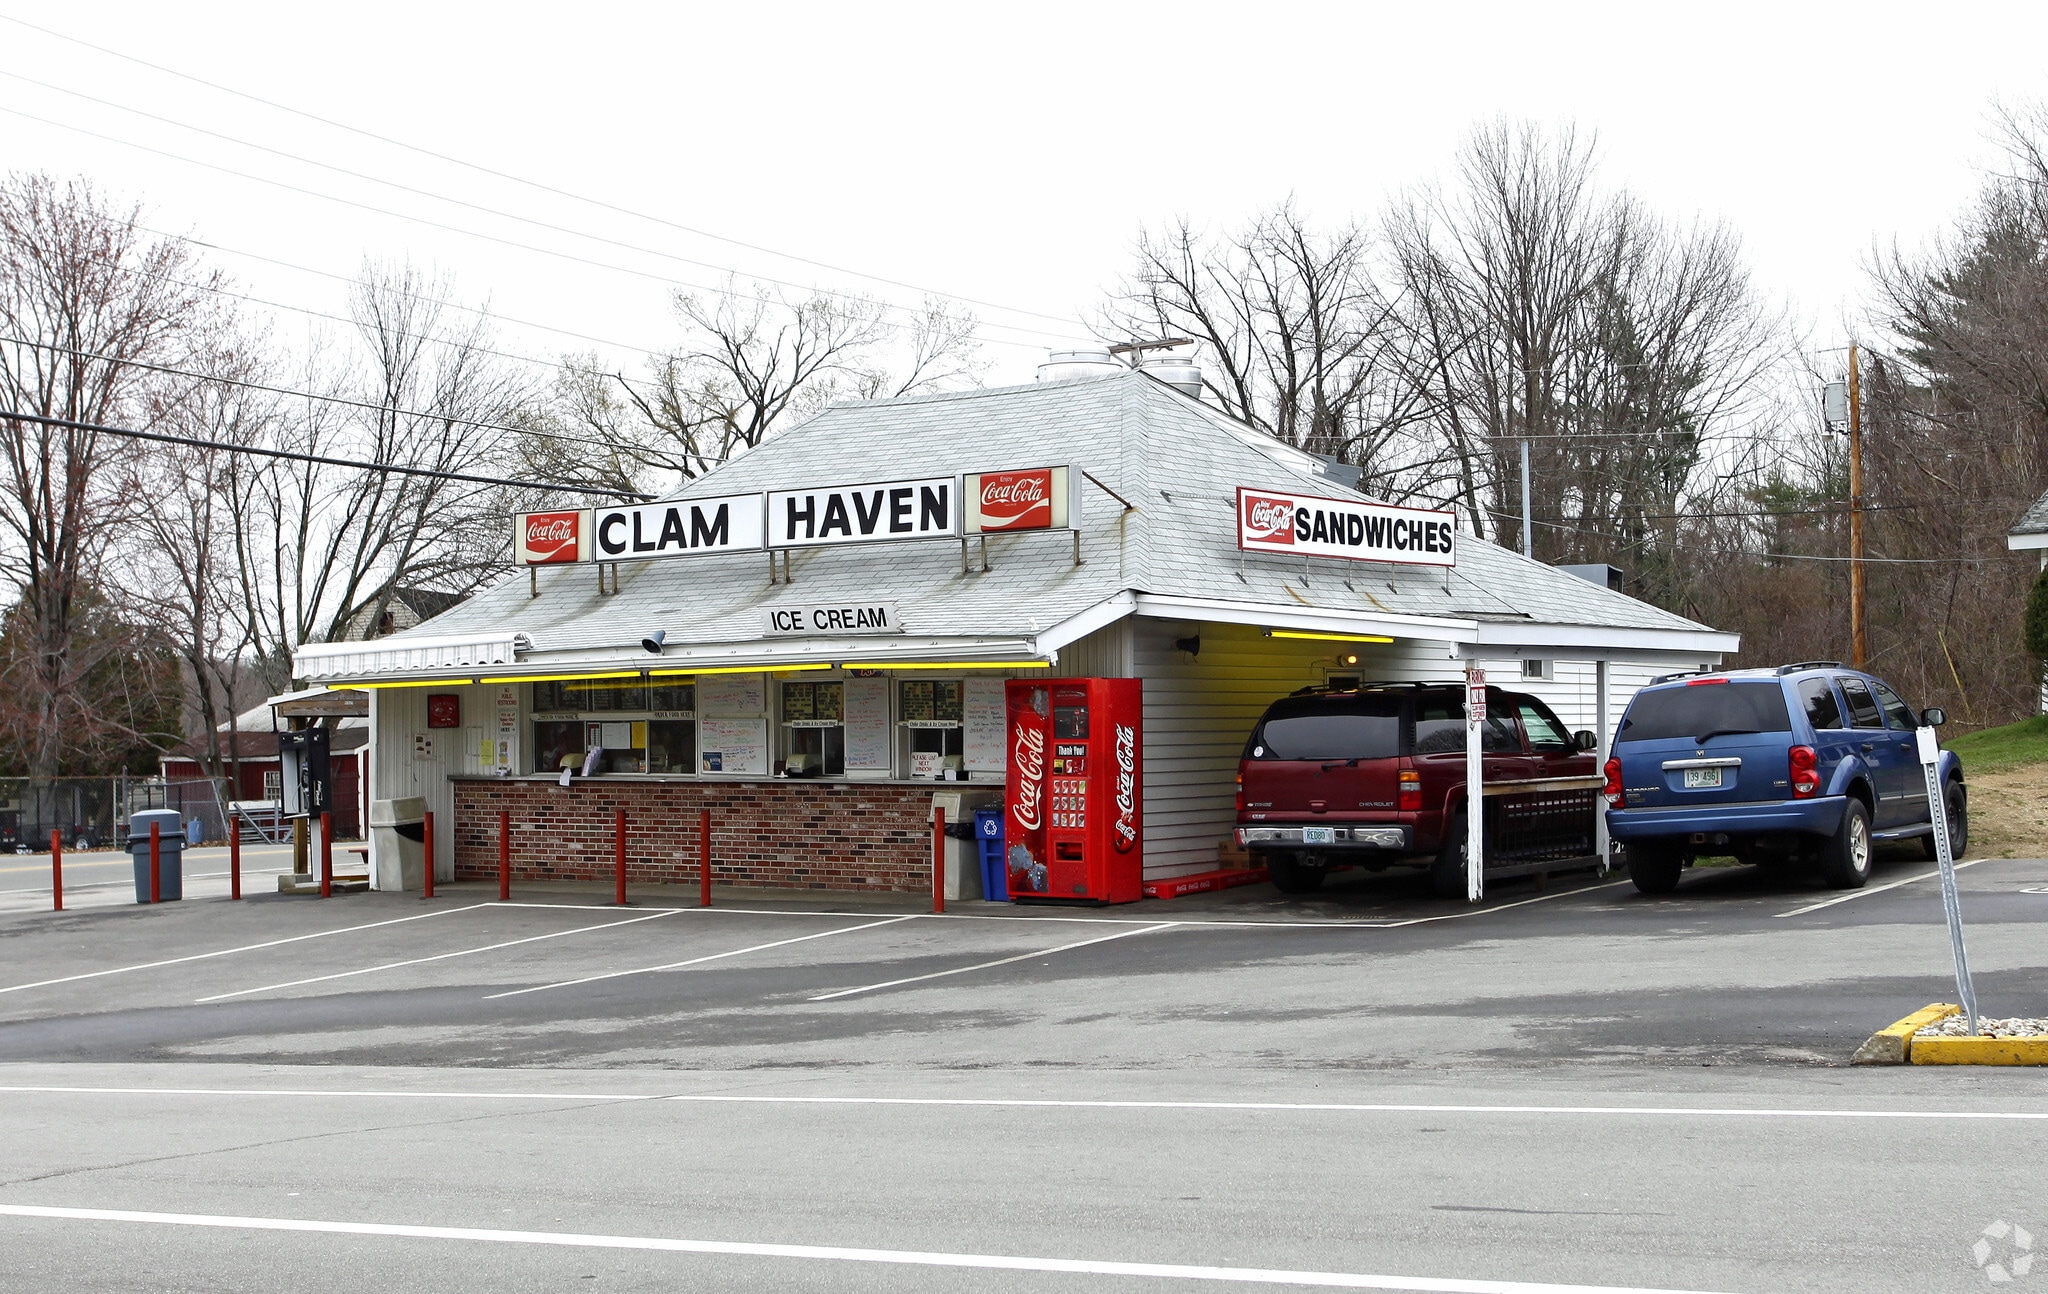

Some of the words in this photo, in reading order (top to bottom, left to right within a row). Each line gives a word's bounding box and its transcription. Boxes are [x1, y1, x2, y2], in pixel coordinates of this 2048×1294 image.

[982, 478, 1044, 505] Coca-Cola
[599, 503, 728, 555] CLAM
[786, 484, 948, 540] HAVEN
[1251, 502, 1292, 530] Coca-Cola
[527, 519, 573, 542] Coca-Cola
[1295, 507, 1452, 554] SANDWICHES
[770, 610, 804, 631] ICE
[813, 607, 888, 630] CREAM
[1058, 745, 1072, 756] Thank
[1073, 745, 1085, 756] You!
[1013, 721, 1044, 831] Coca-Cola
[1116, 723, 1134, 813] Coca-Cola
[1687, 772, 1699, 781] 139
[1703, 771, 1719, 780] 4961
